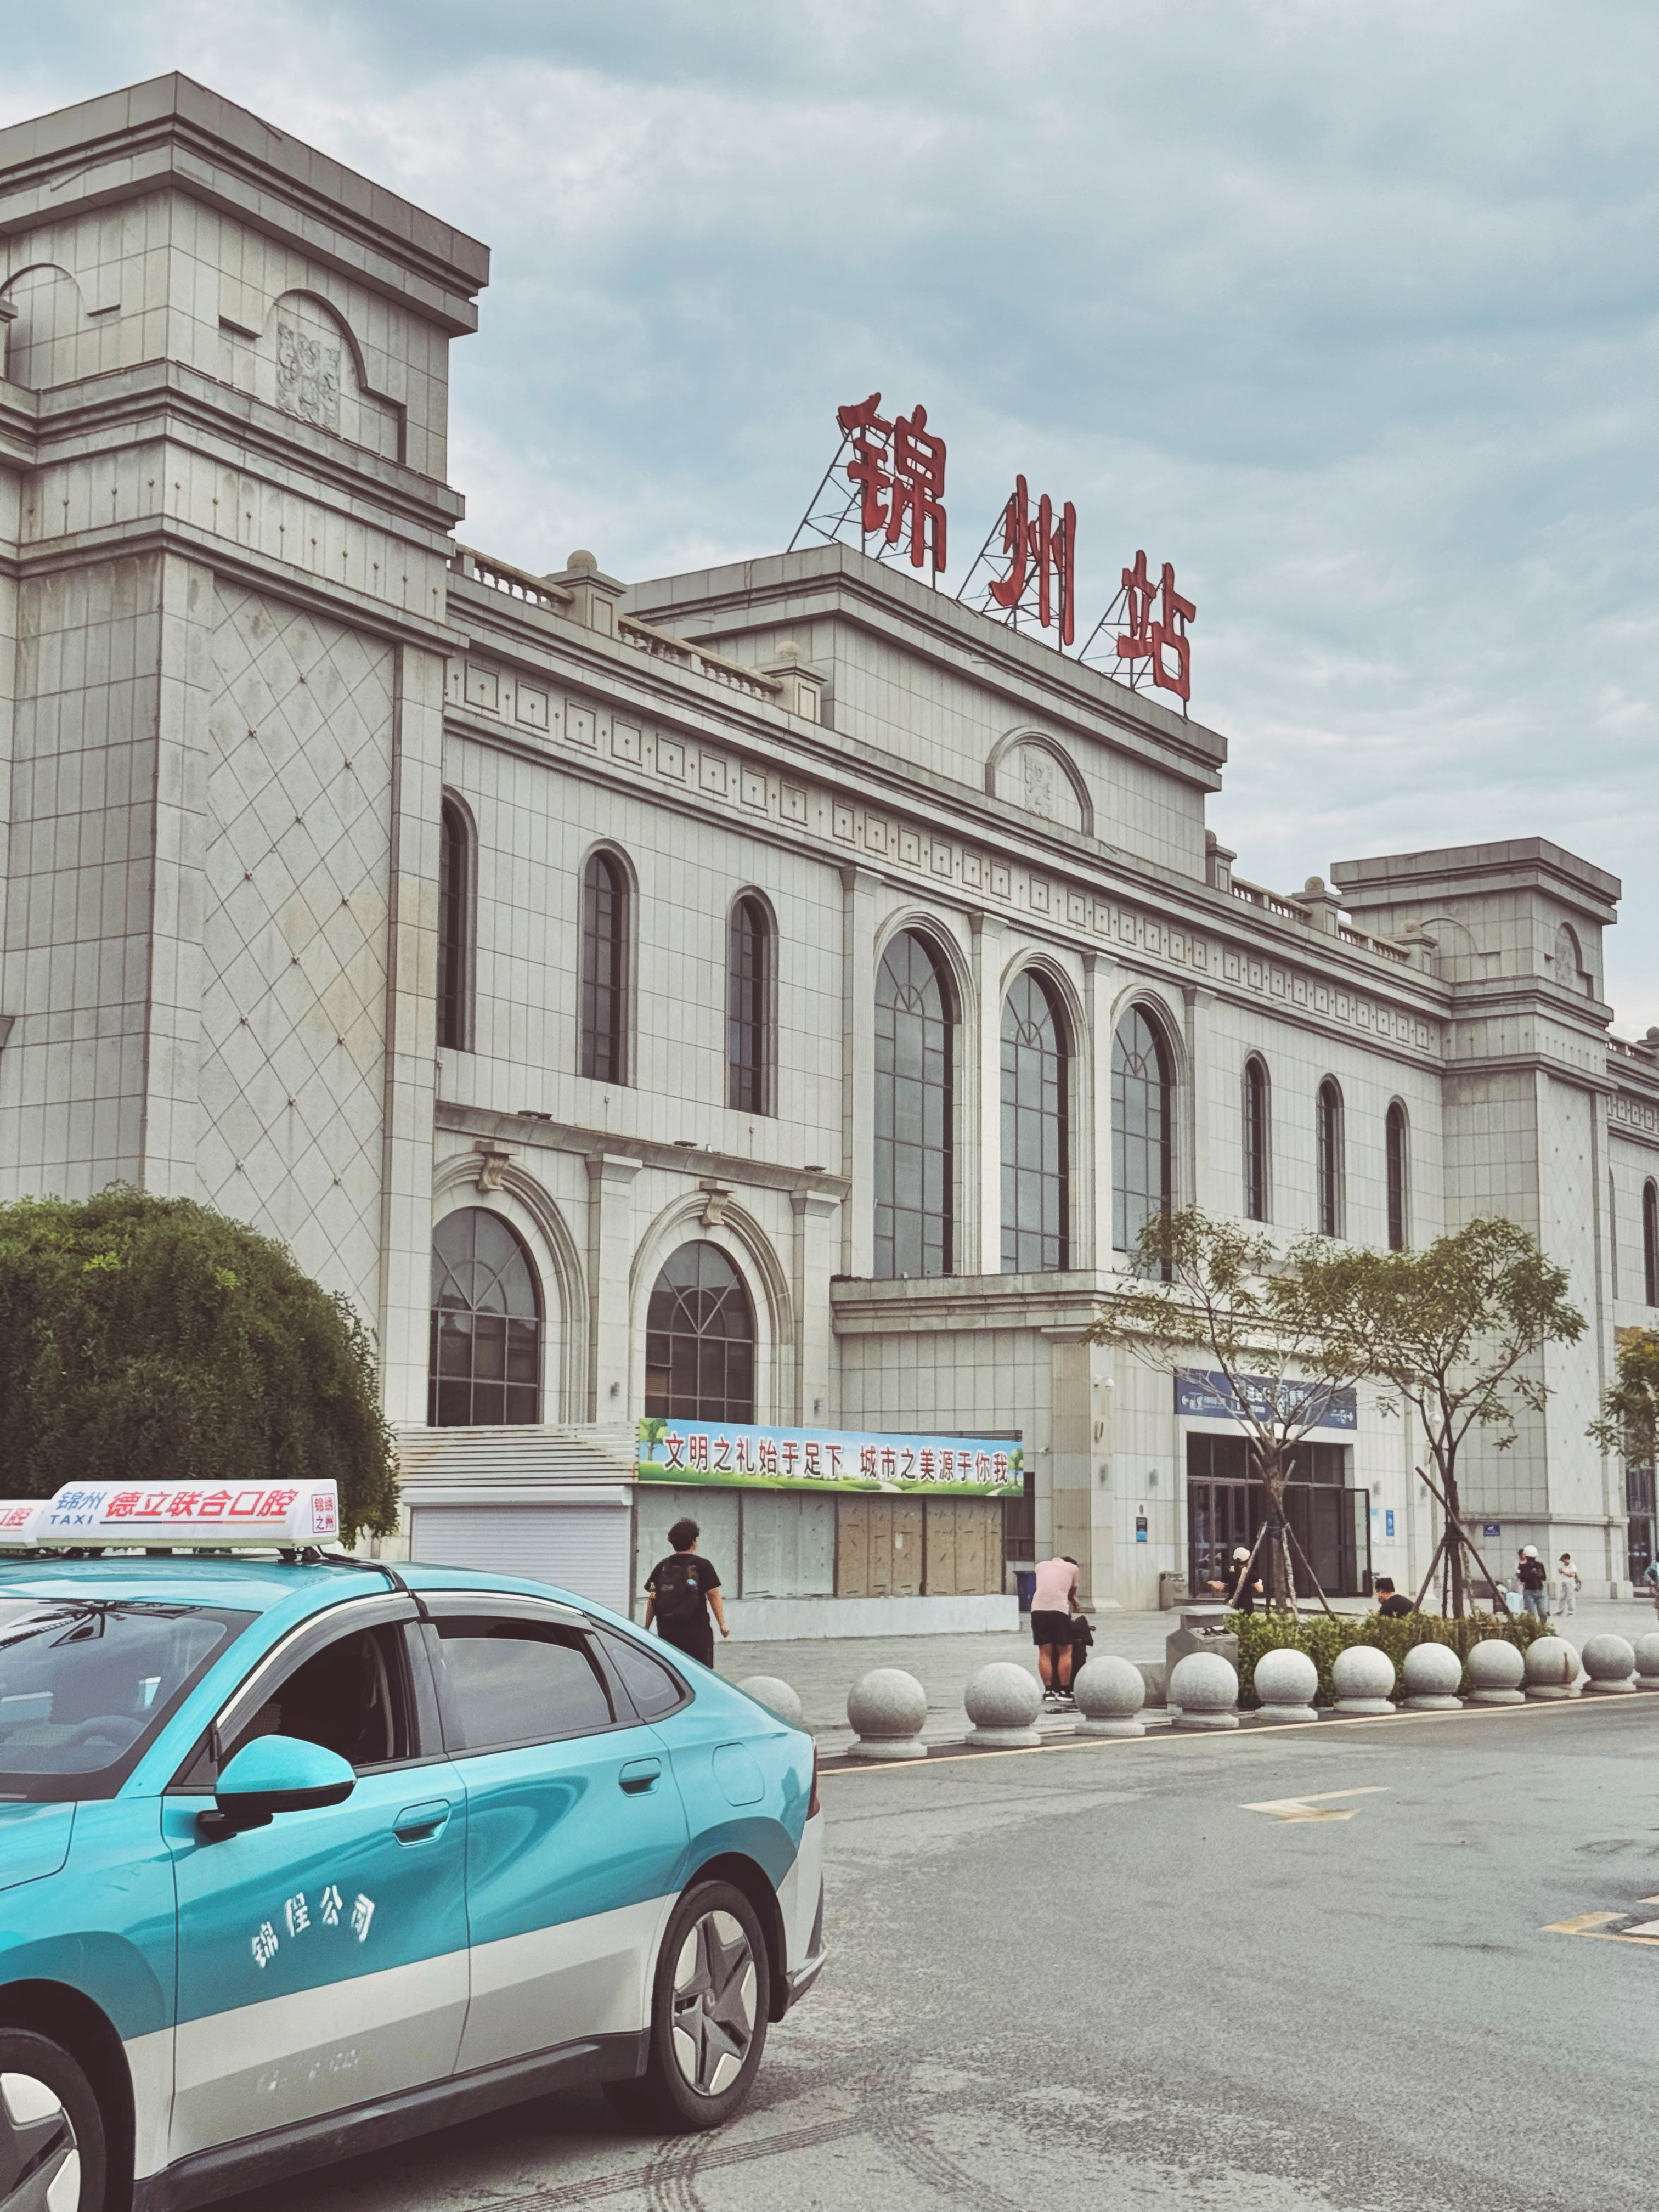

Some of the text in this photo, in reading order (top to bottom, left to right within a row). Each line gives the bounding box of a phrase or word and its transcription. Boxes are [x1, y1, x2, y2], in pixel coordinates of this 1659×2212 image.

[838, 392, 1197, 702] 锦州站
[664, 1432, 1008, 1483] 文明之礼始于足下 城市之美源于你我
[56, 1491, 108, 1510] 锦州
[105, 1489, 299, 1517] 德立联合口腔
[50, 1515, 93, 1525] TAXI
